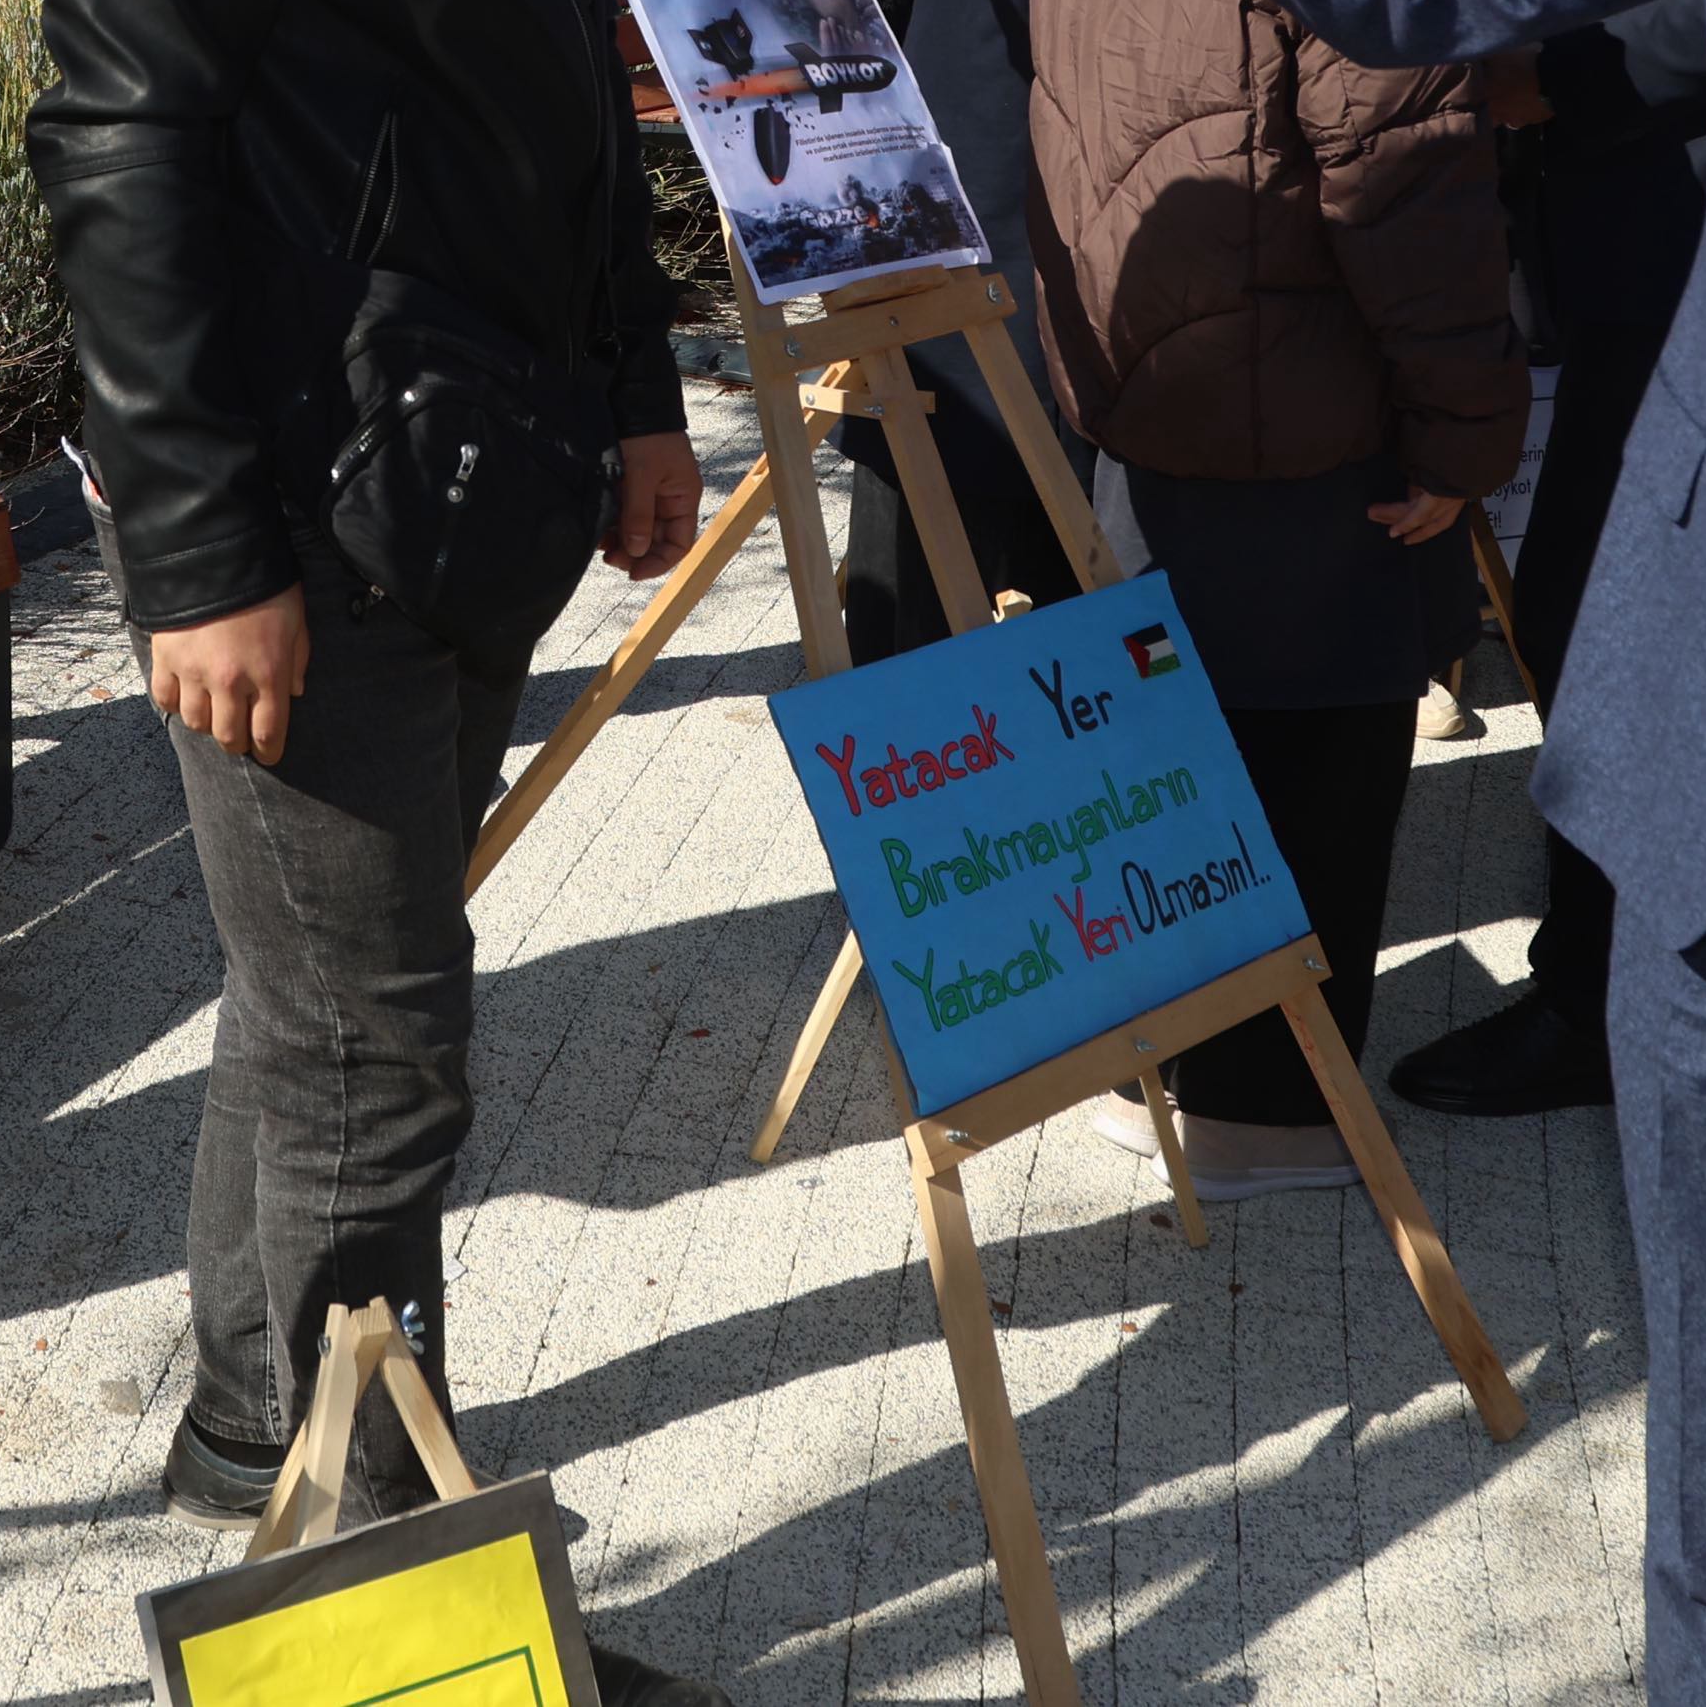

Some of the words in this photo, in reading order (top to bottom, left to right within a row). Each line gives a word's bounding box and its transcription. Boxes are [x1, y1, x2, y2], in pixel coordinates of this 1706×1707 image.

[804, 61, 885, 87] BOYKOT
[815, 704, 1015, 816] Yatacak
[1028, 659, 1114, 739] Yer
[892, 918, 1064, 1032] Yatacak
[1054, 885, 1134, 961] Yeri
